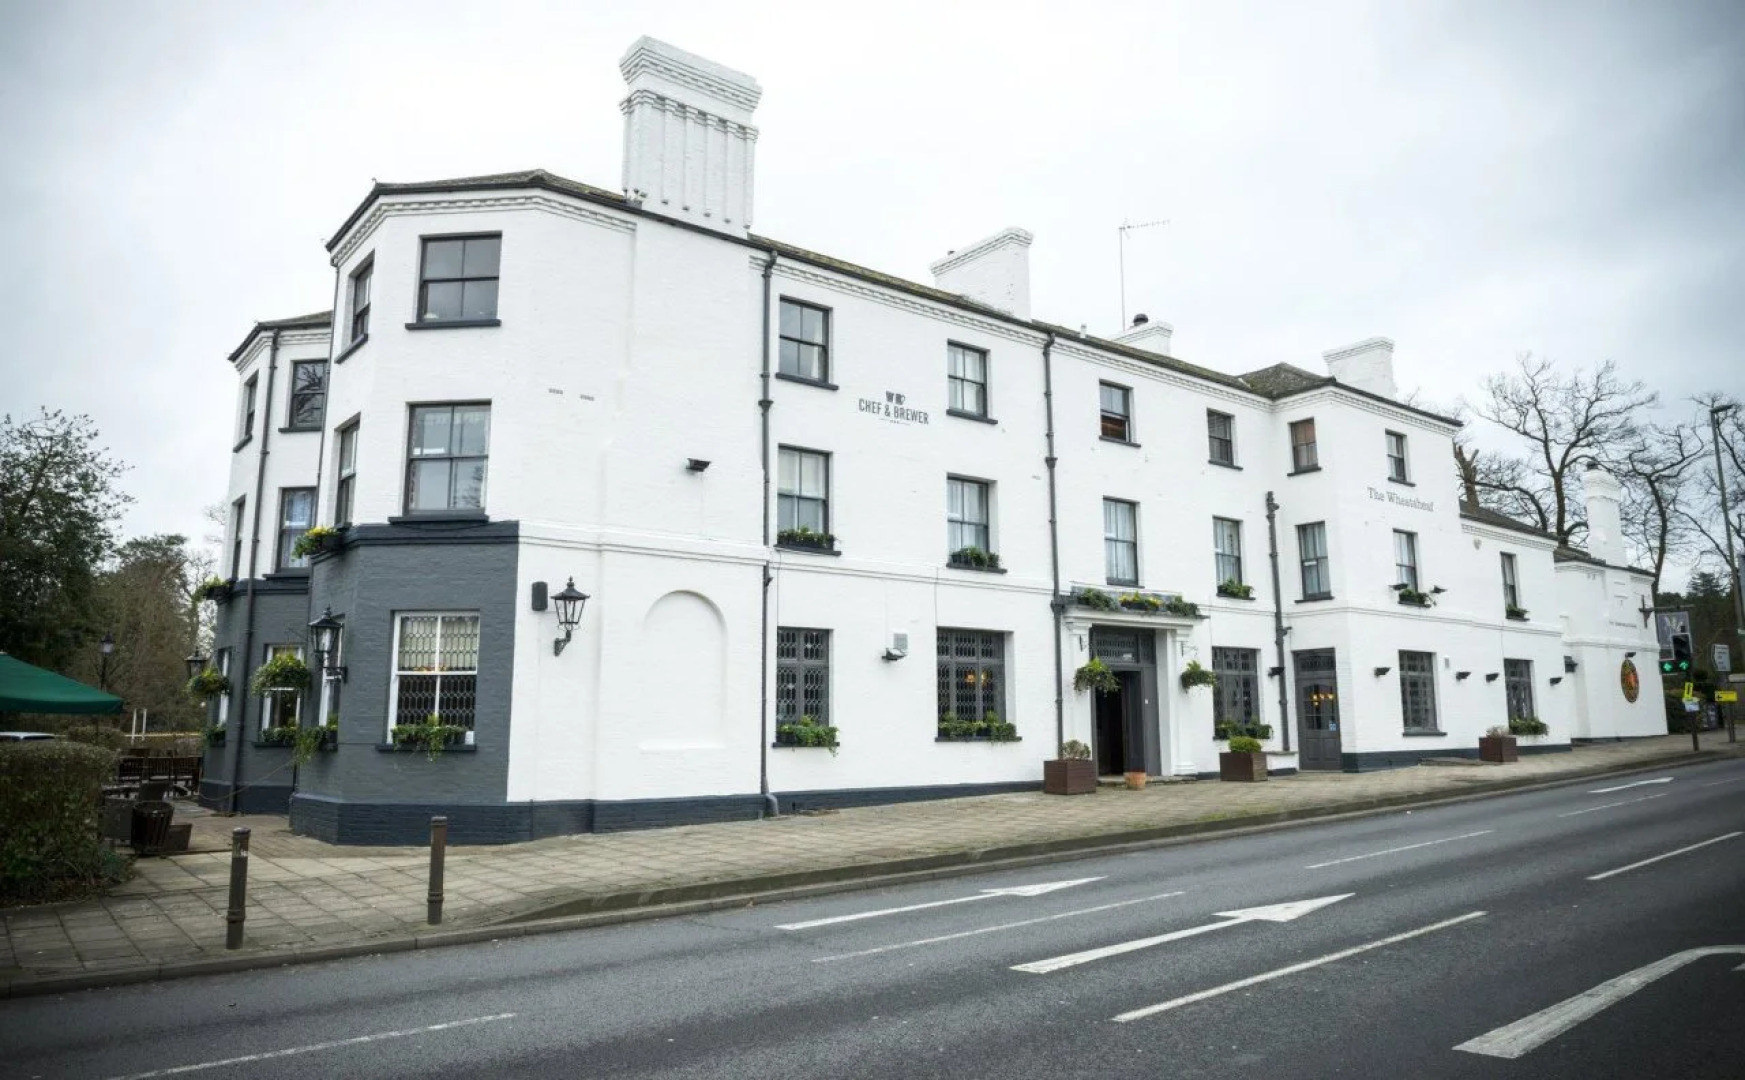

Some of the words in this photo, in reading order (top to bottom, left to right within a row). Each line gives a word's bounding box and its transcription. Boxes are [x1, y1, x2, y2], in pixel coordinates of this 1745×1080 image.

[858, 398, 882, 414] CHEF
[884, 404, 891, 417] &
[893, 406, 929, 425] BREWER
[1367, 487, 1385, 502] The
